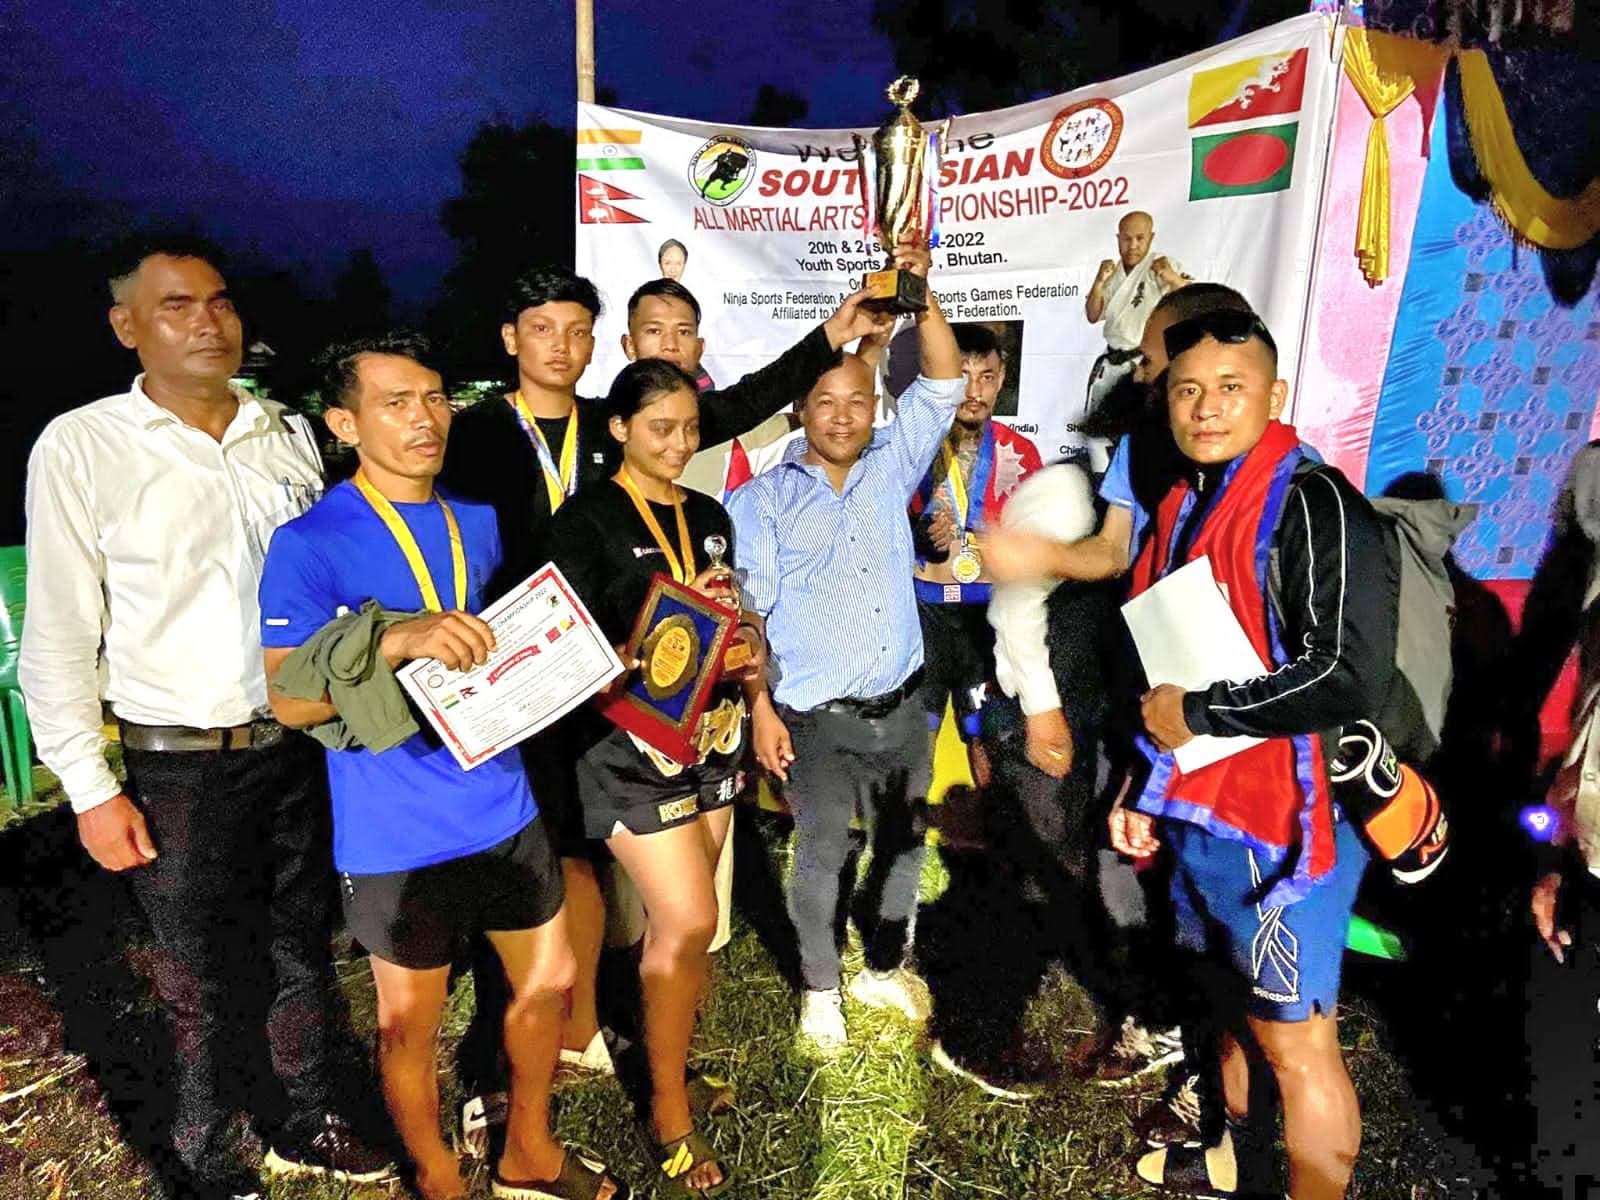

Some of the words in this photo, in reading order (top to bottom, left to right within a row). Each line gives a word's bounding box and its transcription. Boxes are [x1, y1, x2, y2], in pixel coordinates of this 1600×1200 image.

[758, 168, 862, 197] SOUT
[938, 148, 1034, 188] SIAN
[694, 207, 724, 230] ALL
[724, 208, 805, 231] MARTIAL
[809, 205, 866, 231] ARTS
[939, 176, 1129, 223] PIONSHIP-2022
[808, 241, 838, 255] 20th
[841, 242, 852, 253] &
[796, 258, 833, 272] Youth
[837, 257, 881, 273] Sports
[947, 251, 1008, 267] Bhutan.
[723, 291, 748, 307] Ninja
[751, 292, 783, 306] Sports
[786, 291, 837, 305] Federation
[970, 287, 1013, 302] Games
[1016, 283, 1079, 300] Federation
[772, 306, 816, 320] Affiliated
[820, 307, 830, 320] to
[957, 304, 1022, 319] Federation.
